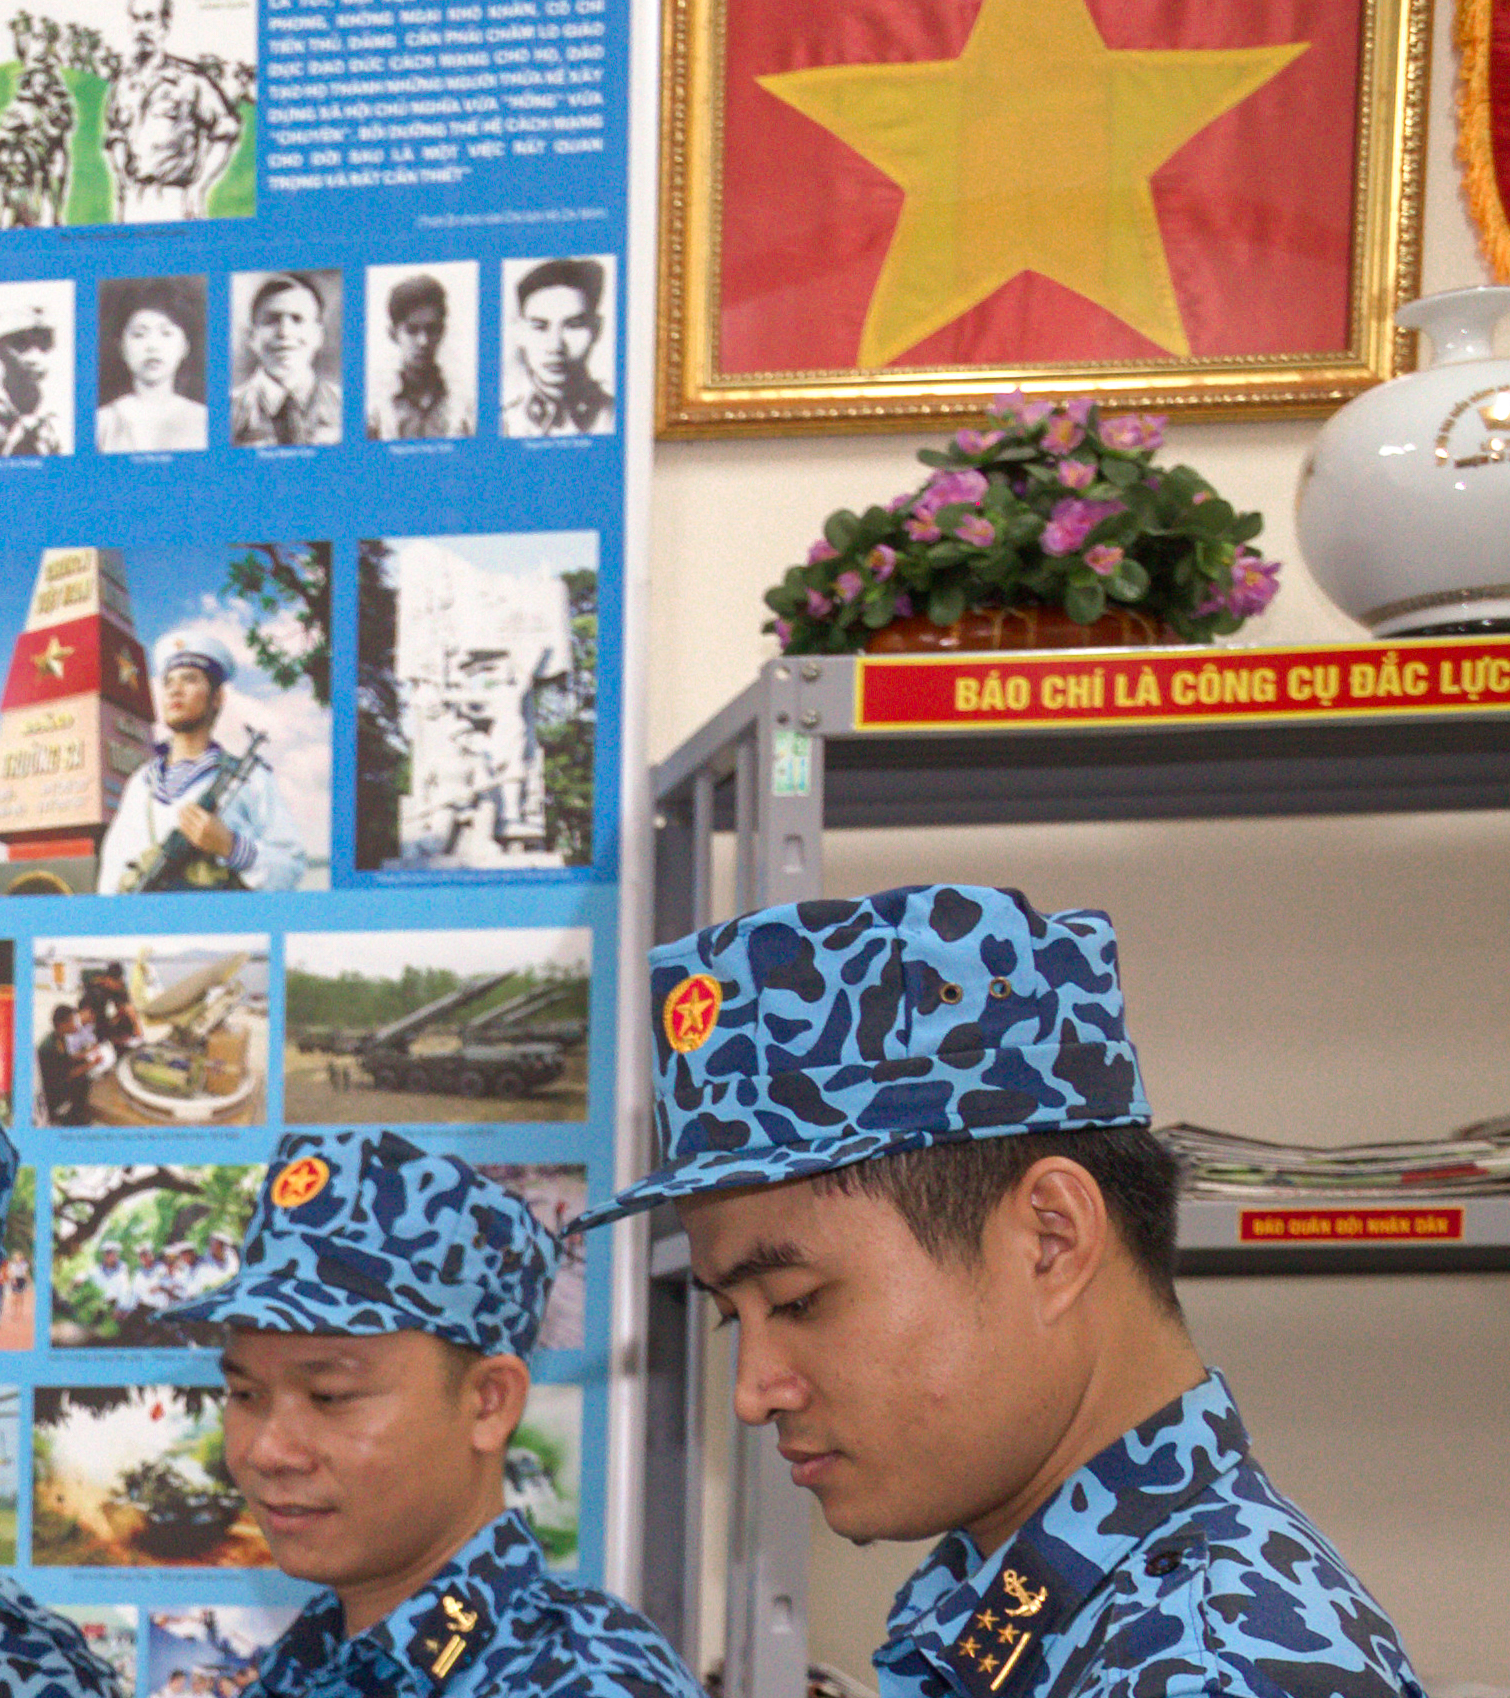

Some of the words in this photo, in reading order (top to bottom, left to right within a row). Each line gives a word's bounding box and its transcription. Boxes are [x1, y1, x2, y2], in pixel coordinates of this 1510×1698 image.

[955, 667, 1030, 710] BÁO
[1041, 665, 1104, 706] CHÍ
[1115, 664, 1160, 704] LÀ
[1171, 661, 1276, 703] CÔNG
[1287, 662, 1338, 703] CỤ
[1349, 649, 1428, 694] ĐẮC
[1440, 654, 1510, 699] LỰC
